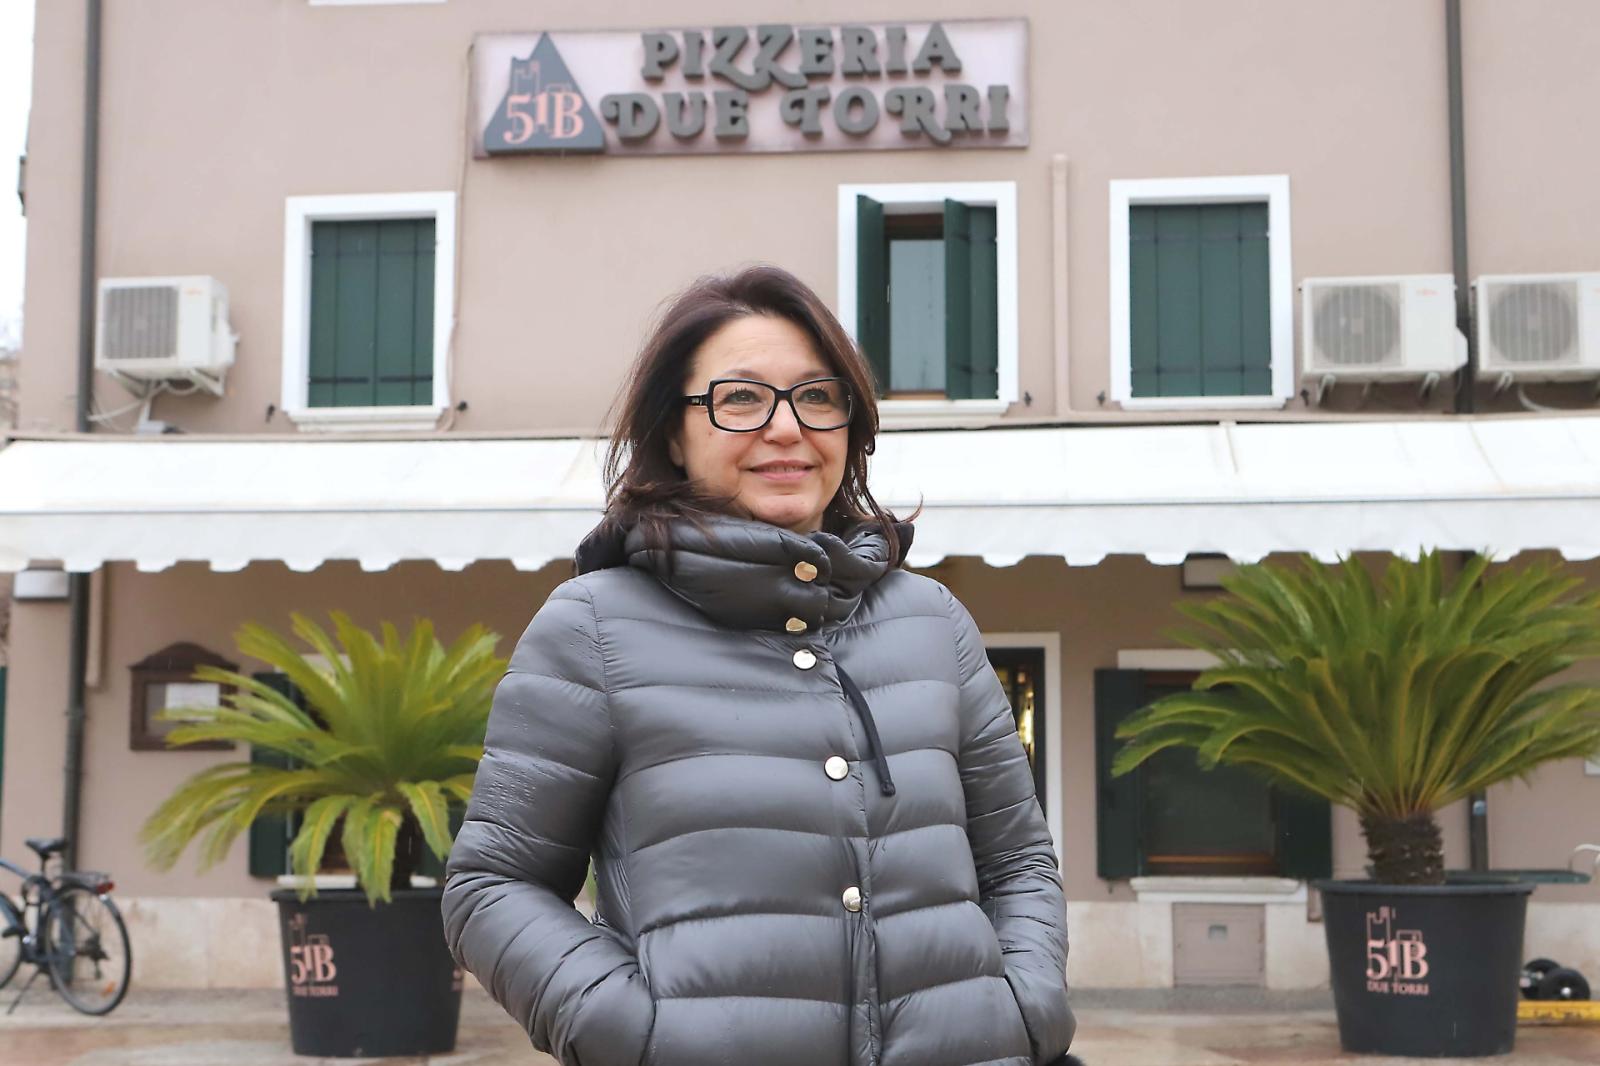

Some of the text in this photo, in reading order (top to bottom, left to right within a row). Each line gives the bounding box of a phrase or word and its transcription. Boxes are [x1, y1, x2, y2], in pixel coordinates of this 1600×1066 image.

[641, 23, 961, 91] PIZZERIA
[503, 91, 584, 144] 51B
[602, 85, 1010, 146] DUE TORRI
[290, 944, 337, 984] 51B
[1366, 940, 1429, 980] 51B
